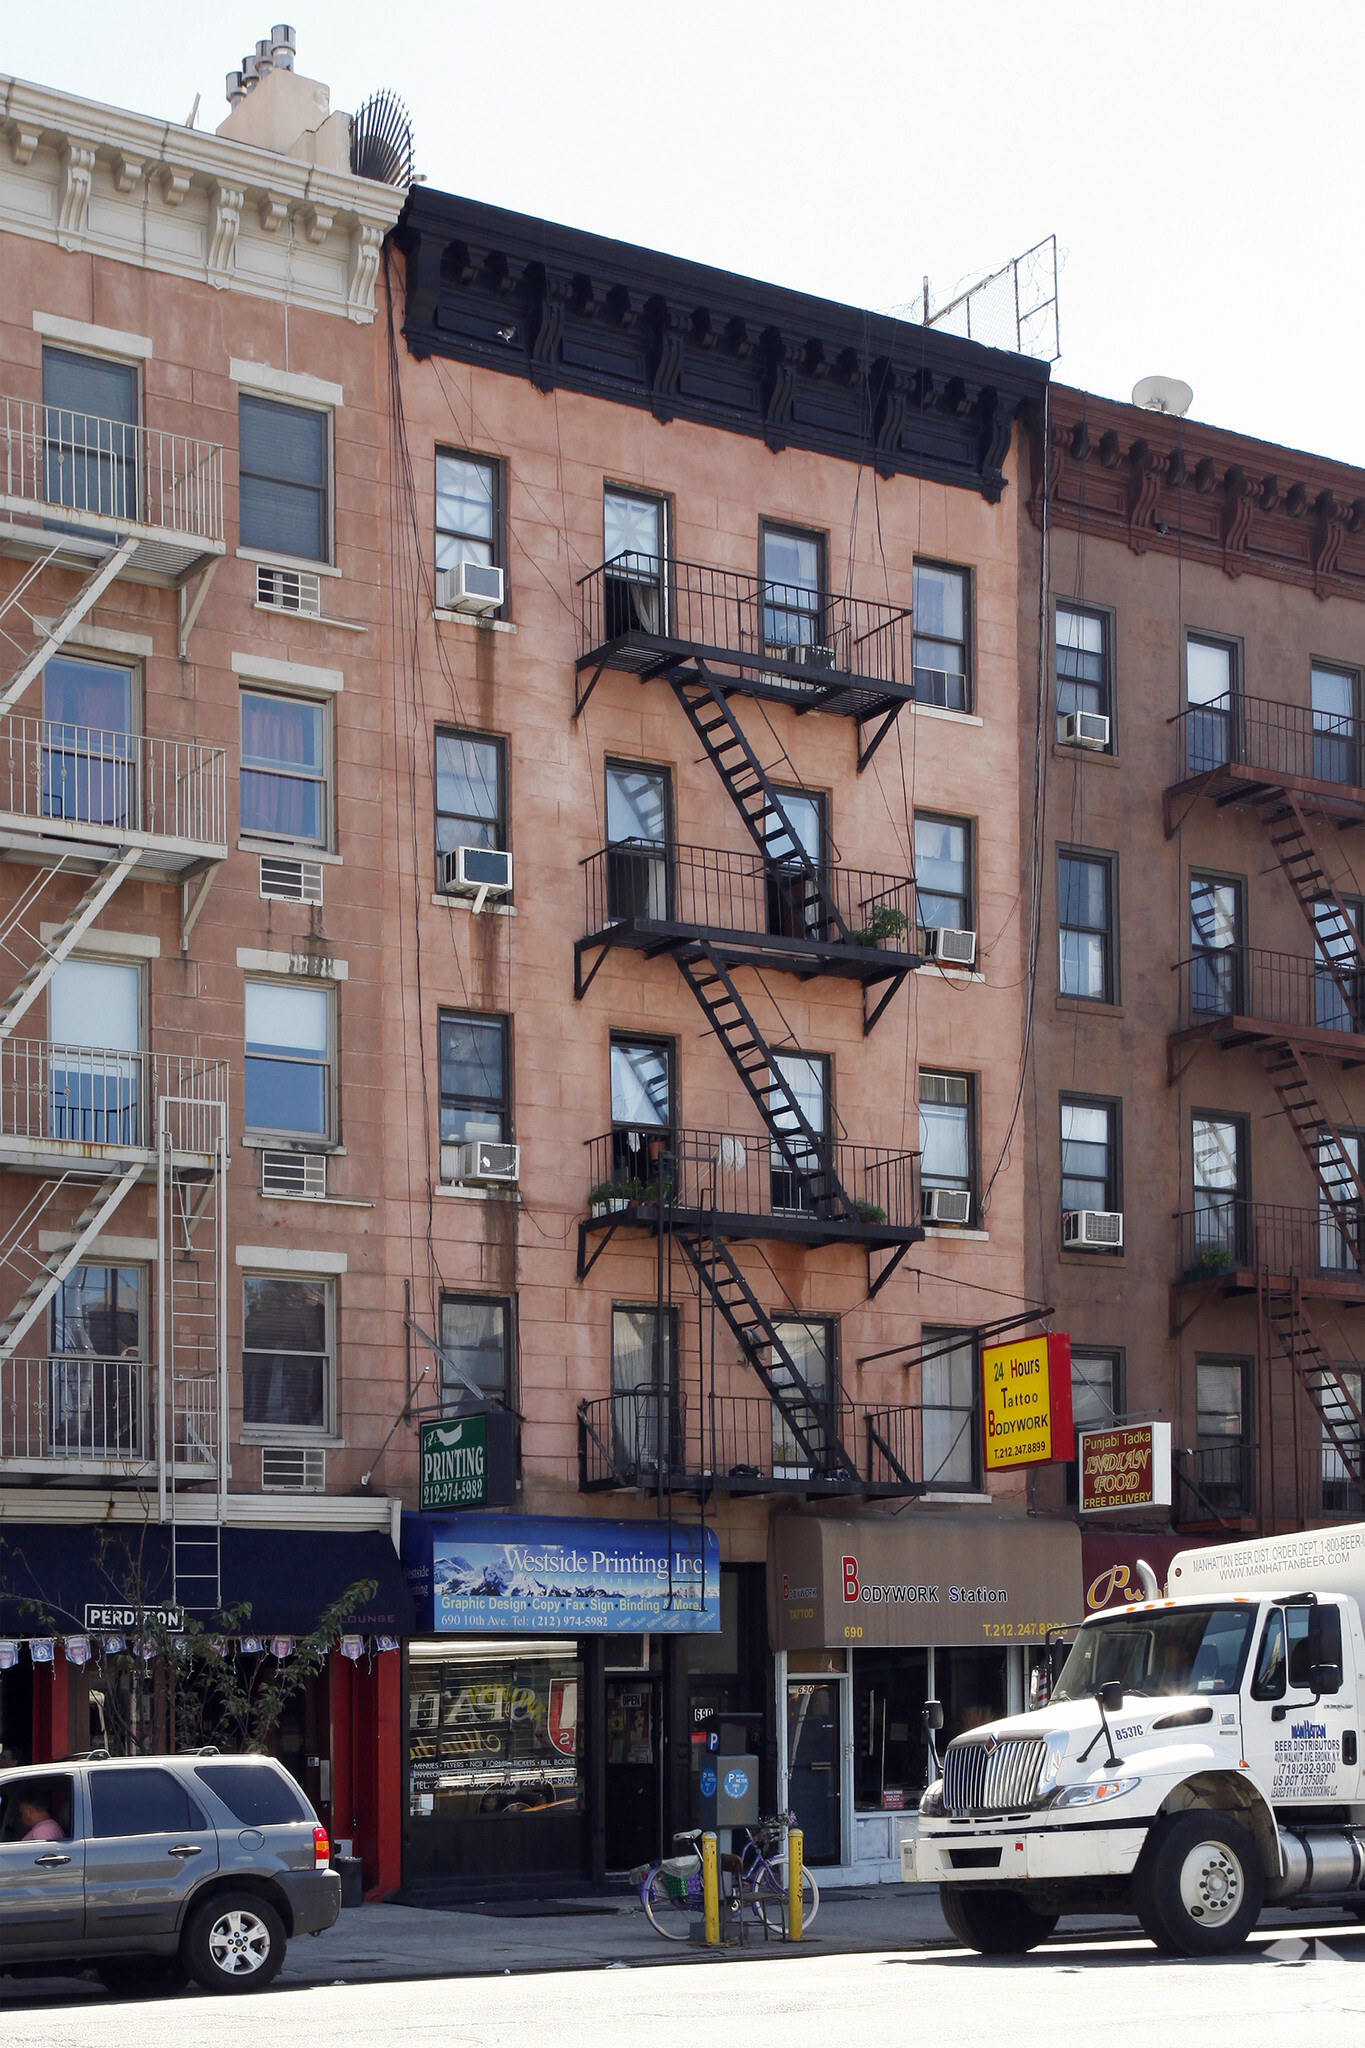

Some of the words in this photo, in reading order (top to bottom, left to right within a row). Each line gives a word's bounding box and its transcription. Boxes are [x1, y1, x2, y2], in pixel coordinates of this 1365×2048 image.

[993, 1362, 1005, 1382] 24
[1010, 1358, 1040, 1378] Hours
[1001, 1387, 1038, 1409] Tattoo
[988, 1409, 1048, 1437] BODYWORK
[994, 1440, 1046, 1460] T.212.247.8899
[1084, 1436, 1120, 1452] Punjabi
[1122, 1430, 1151, 1445] Tadka
[424, 1445, 485, 1482] PRINTING
[1085, 1448, 1151, 1475] INDIAN
[424, 1478, 483, 1505] 212-974-5982
[1094, 1472, 1140, 1494] FOOD
[1084, 1496, 1106, 1509] FREE
[1108, 1491, 1151, 1506] DELIVERY
[504, 1549, 588, 1574] Westside
[591, 1550, 669, 1580] Printing
[674, 1552, 708, 1574] Inc.
[1193, 1554, 1233, 1573] MANHATTAN
[1234, 1551, 1253, 1567] BEER
[1254, 1548, 1271, 1563] DIST.
[1272, 1543, 1298, 1560] ORDER
[1299, 1540, 1319, 1556] DEPT.
[1219, 1552, 1350, 1580] WWW.MANHATTANBEER.COM
[545, 1576, 633, 1586] Everything
[841, 1555, 939, 1603] BODYWORK
[949, 1586, 1008, 1603] Station
[441, 1596, 486, 1612] Graphic
[489, 1597, 527, 1613] Design
[532, 1598, 561, 1613] Copy
[565, 1598, 586, 1611] Fax
[590, 1598, 614, 1613] Sign
[619, 1598, 660, 1614] Binding
[790, 1608, 814, 1619] TATTOO
[340, 1614, 395, 1624] LOUNGE
[441, 1614, 461, 1626] 690
[464, 1614, 484, 1626] 10th
[487, 1615, 509, 1626] Ave.
[511, 1614, 530, 1626] Tel:
[563, 1615, 608, 1628] 974-5982
[844, 1626, 863, 1639] 690
[797, 1684, 814, 1694] 690
[468, 1683, 547, 1721] PRINTING
[622, 1694, 641, 1706] OPEN
[710, 1732, 718, 1750] P
[1114, 1724, 1144, 1742] B537C
[1275, 1741, 1292, 1751] BEER
[1294, 1740, 1340, 1751] DISTRIBUTORS
[554, 1758, 576, 1766] BOOKS
[1273, 1775, 1283, 1787] US
[1285, 1775, 1299, 1786] DOT
